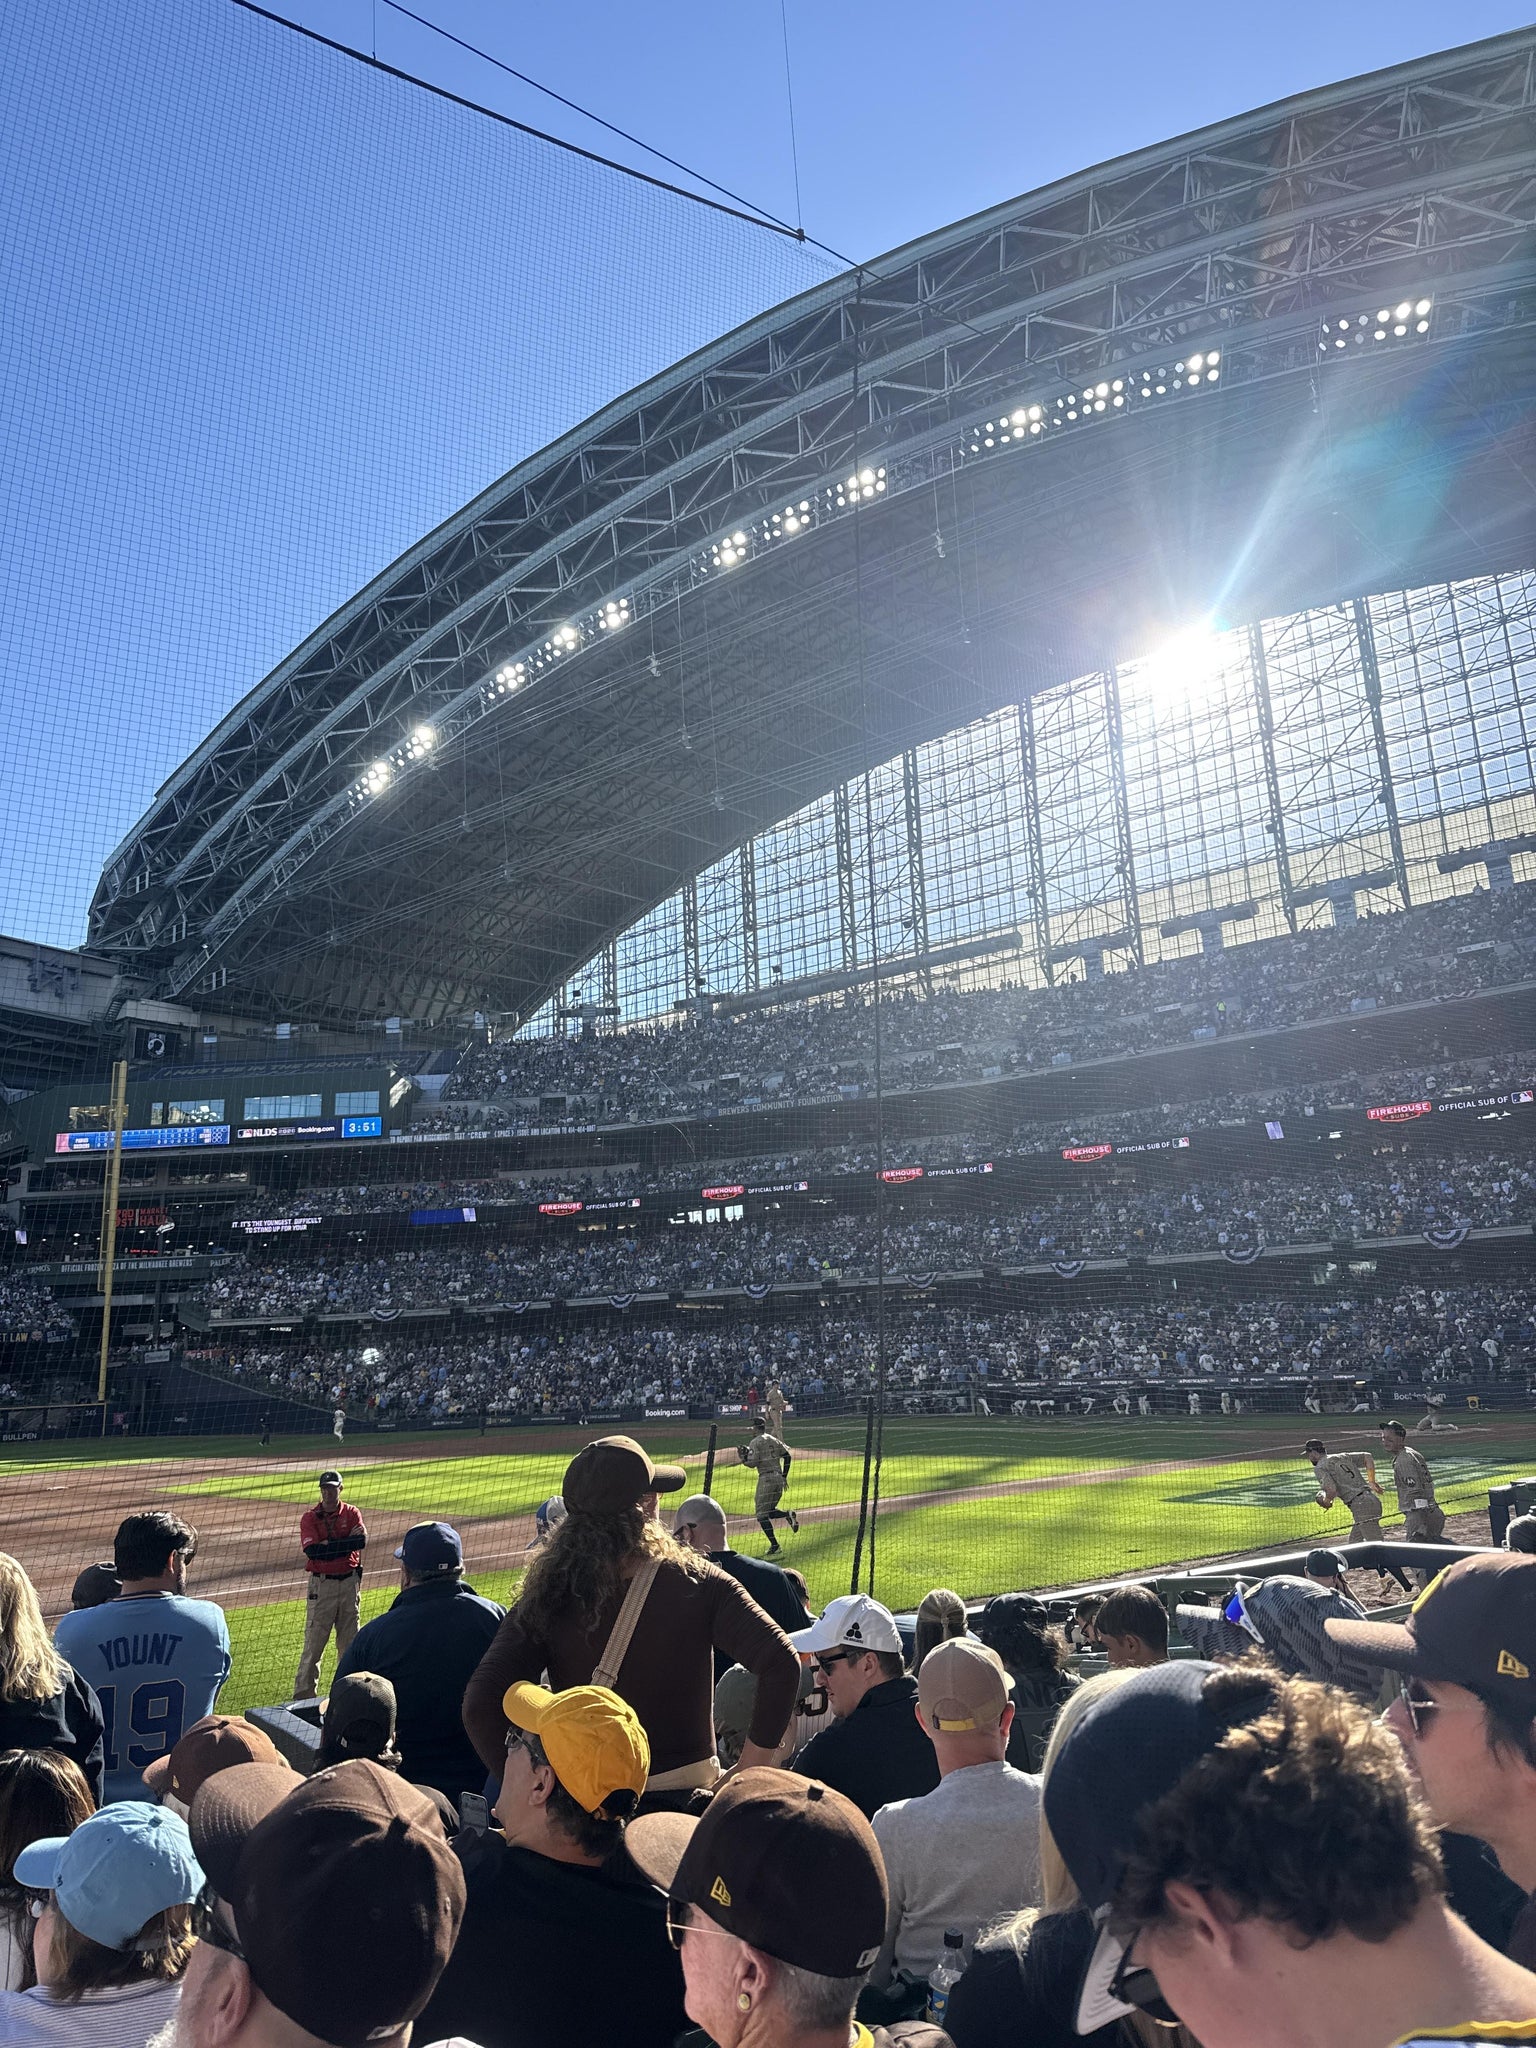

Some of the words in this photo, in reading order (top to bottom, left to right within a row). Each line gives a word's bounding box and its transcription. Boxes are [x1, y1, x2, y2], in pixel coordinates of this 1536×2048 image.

[304, 1061, 361, 1069] FRONT
[718, 1105, 749, 1116] BREWERS
[752, 1100, 795, 1112] COMMUNITY
[797, 1094, 843, 1106] FOUNDATION
[1438, 1101, 1476, 1111] OFFICIAL
[1478, 1097, 1495, 1106] SUB
[1497, 1096, 1509, 1104] OF
[1370, 1102, 1429, 1118] FIREHOUSE
[1390, 1112, 1409, 1120] SUBS
[253, 1127, 278, 1137] NLDS
[297, 1126, 335, 1134] Booking.com
[348, 1122, 376, 1133] 3:51
[467, 1131, 491, 1140] "CREW"
[494, 1129, 514, 1138] (SPACE)
[1064, 1145, 1111, 1157] FIREHOUSE
[1117, 1145, 1146, 1153] OFFICIAL
[1146, 1142, 1160, 1150] SUB
[882, 1168, 920, 1177] IREHOUSE
[704, 1186, 741, 1195] FIREHOUSE
[140, 1207, 168, 1215] MARKET
[140, 1215, 167, 1226] HALL
[294, 1217, 322, 1225] DIFFICULT
[61, 1264, 84, 1273] OFFICIAL
[84, 1263, 104, 1272] FROZEN
[120, 1262, 127, 1270] OF
[138, 1260, 168, 1269] MILWAUKEE
[168, 1259, 193, 1267] BREWERS
[10, 1332, 28, 1343] LAW
[85, 1409, 97, 1417] 345
[645, 1408, 686, 1418] Booking.com
[2, 1432, 37, 1441] BULLPEN
[768, 1445, 776, 1458] 2
[1340, 1463, 1355, 1479] 9
[97, 1633, 184, 1672] YOUNT
[95, 1678, 187, 1772] 19
